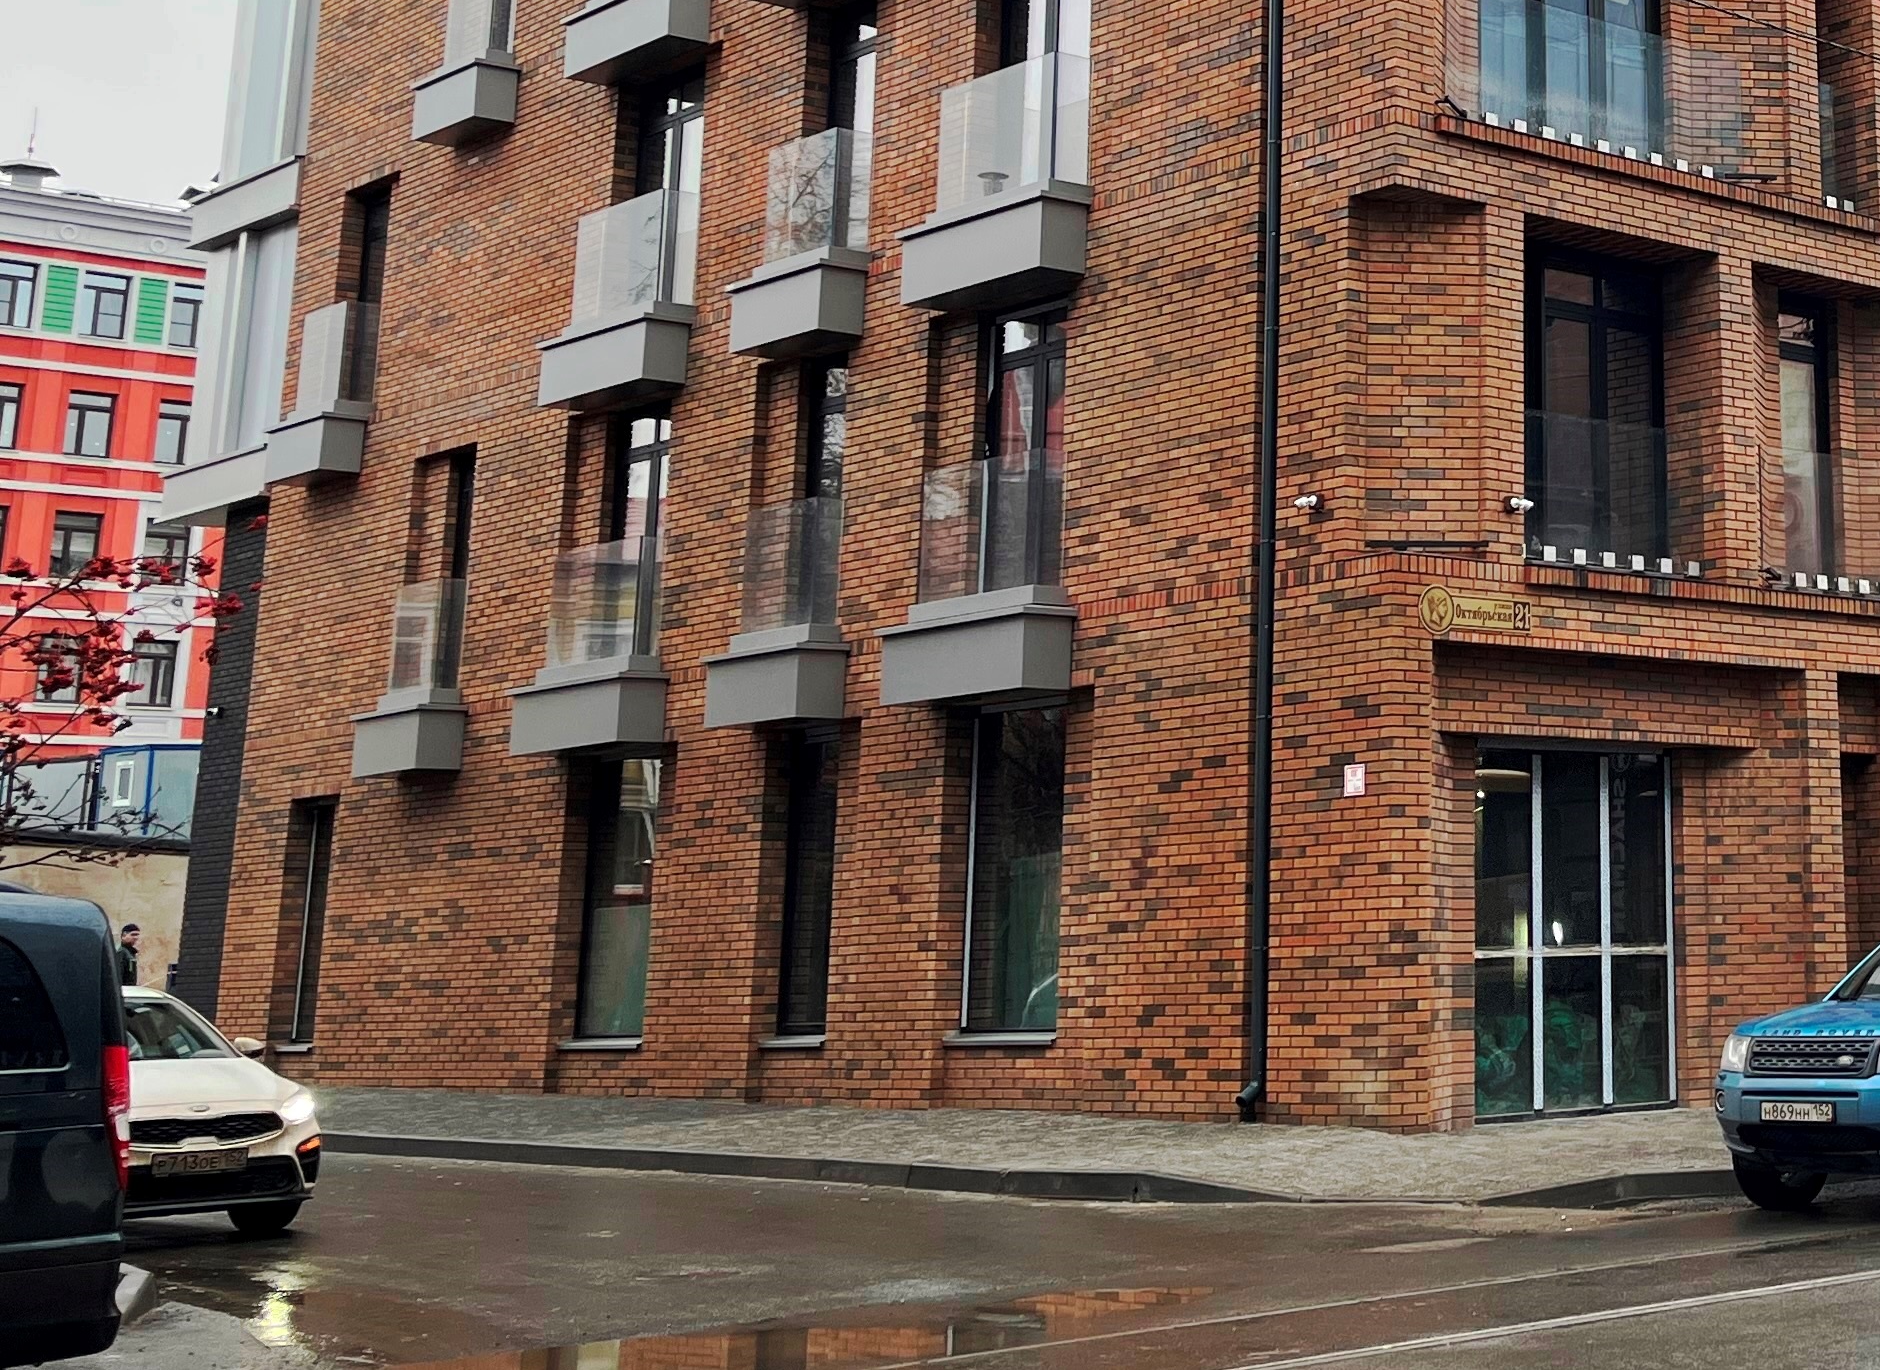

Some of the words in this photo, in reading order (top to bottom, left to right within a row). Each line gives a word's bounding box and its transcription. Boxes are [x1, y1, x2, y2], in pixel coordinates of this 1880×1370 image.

[1455, 603, 1513, 626] Октябрьская
[1514, 603, 1531, 629] 21
[1812, 1103, 1831, 1117] 152
